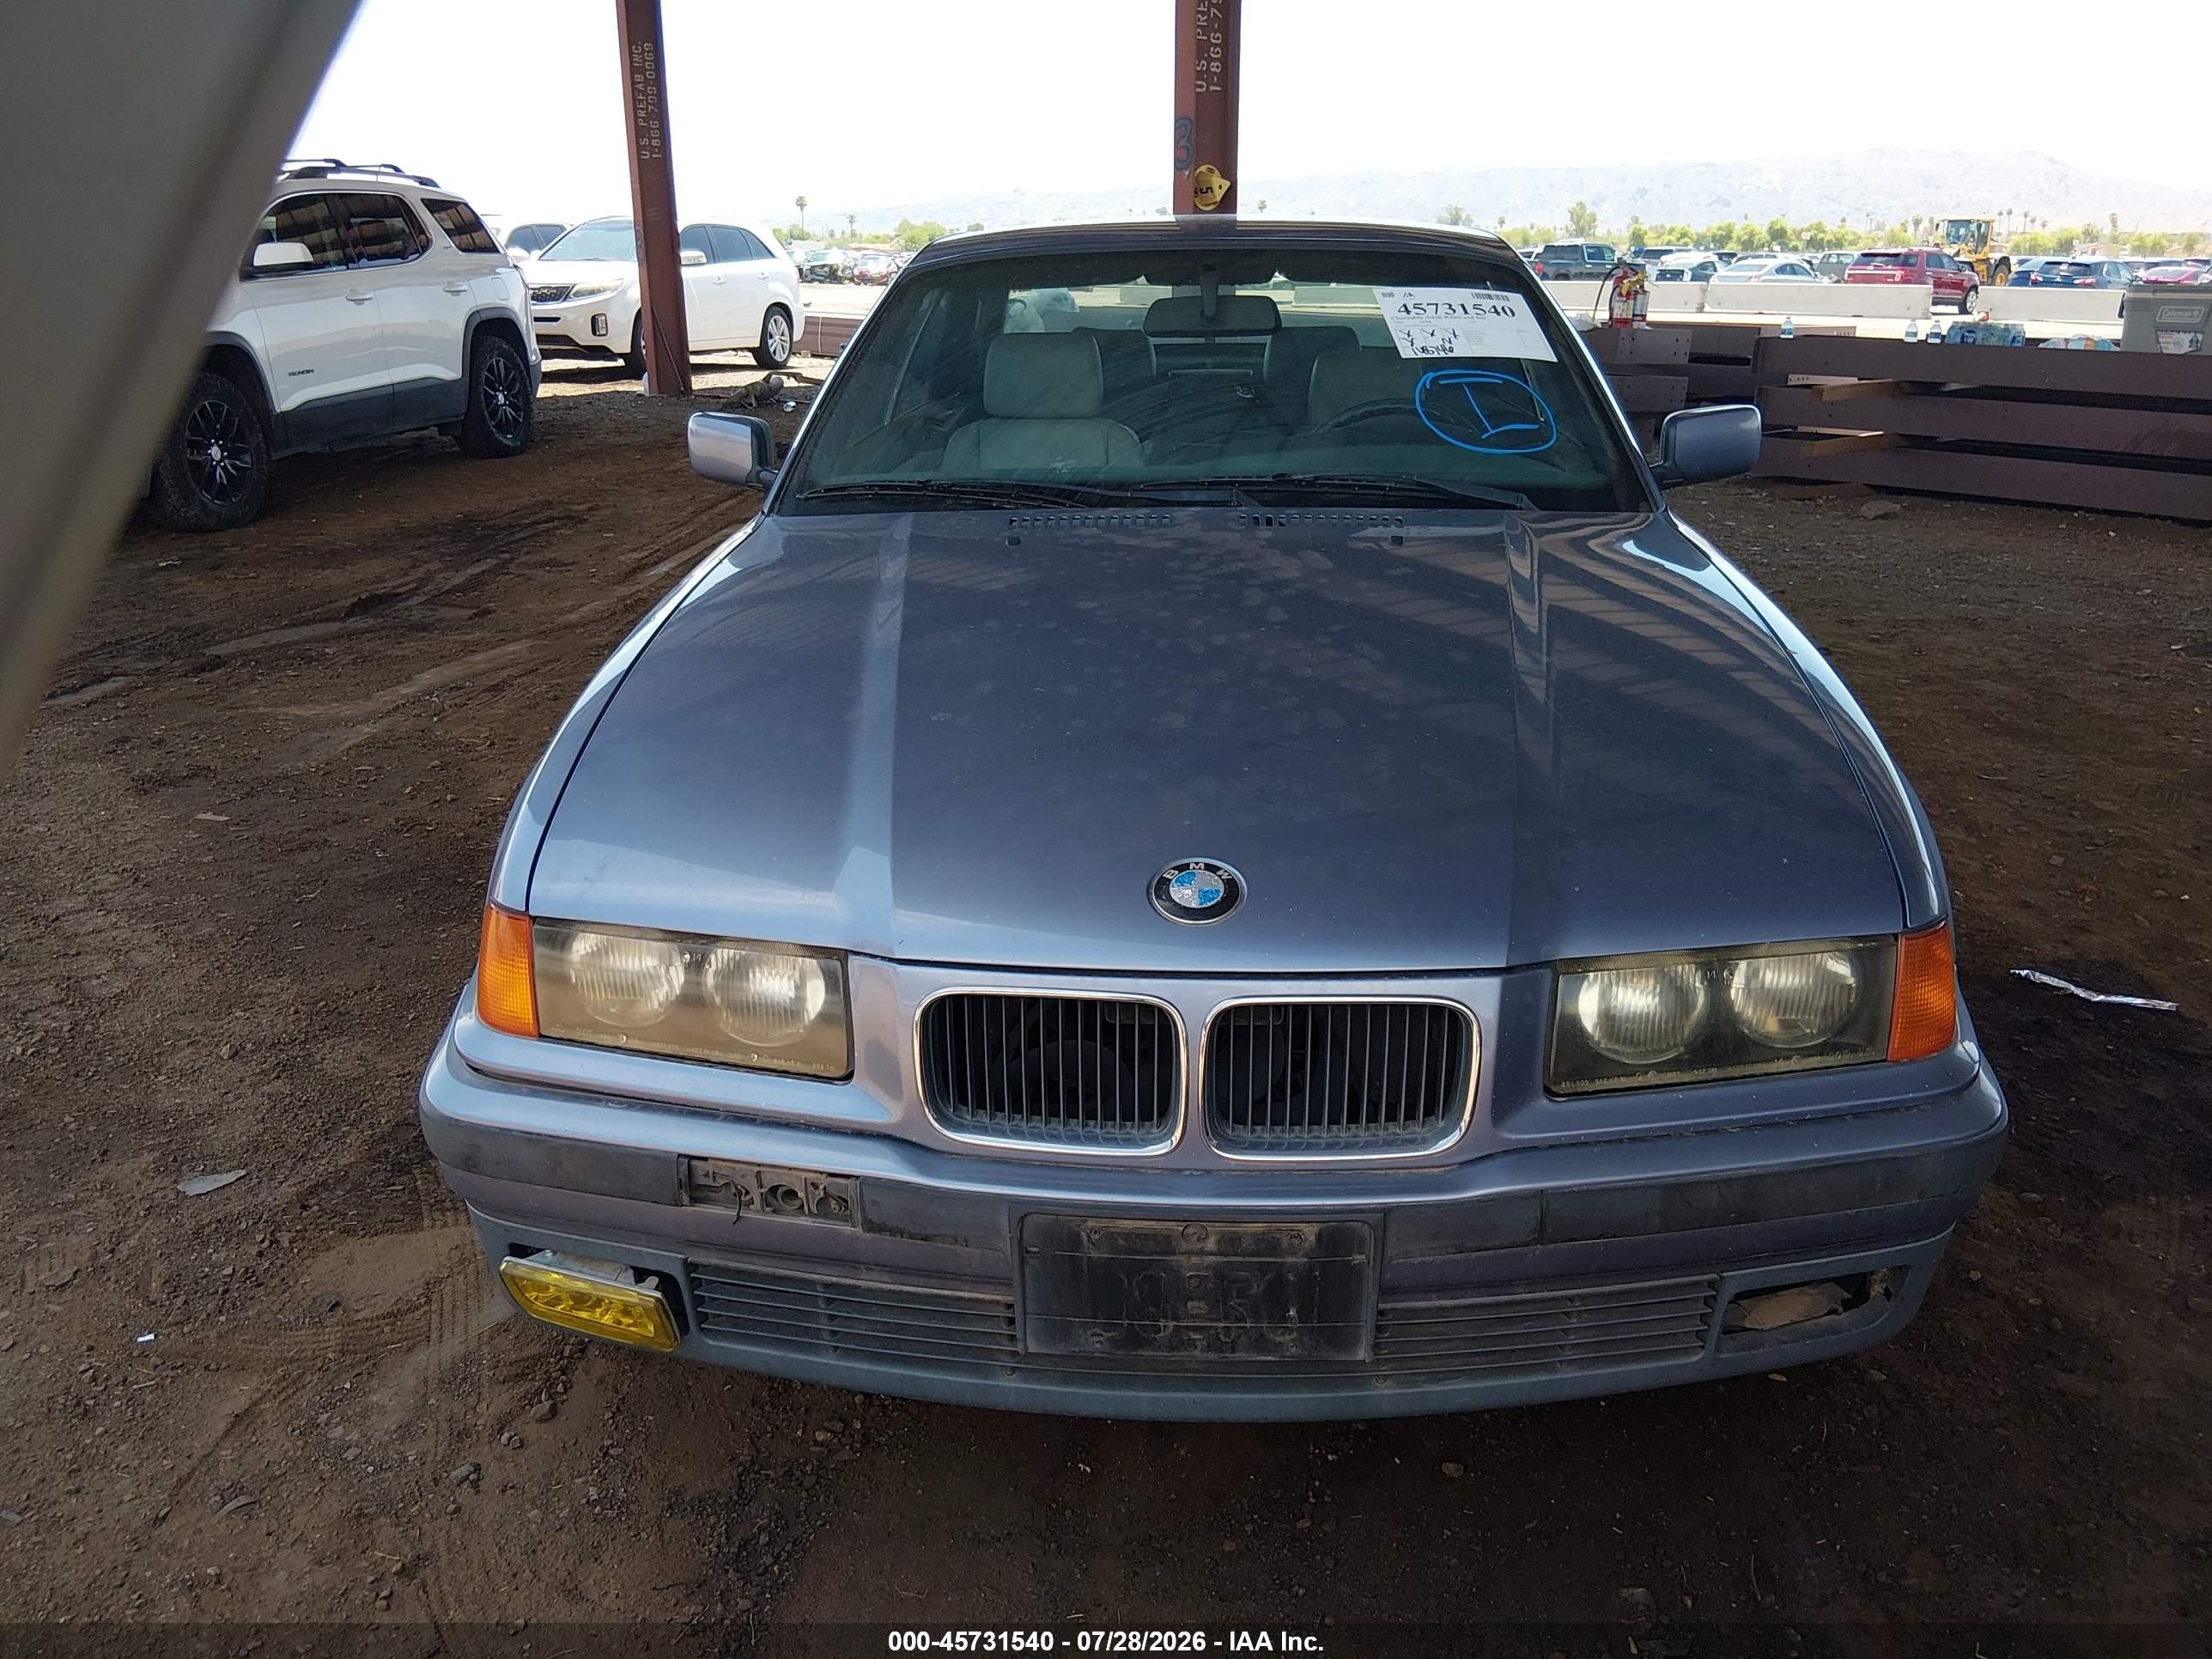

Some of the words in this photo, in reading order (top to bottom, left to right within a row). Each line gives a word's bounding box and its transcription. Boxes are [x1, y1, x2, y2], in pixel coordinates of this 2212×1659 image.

[1195, 53, 1207, 93] U.S.
[634, 74, 647, 125] PREFAB
[639, 133, 650, 159] U.S.
[1397, 302, 1516, 318] 45731540
[1163, 863, 1233, 879] BMW
